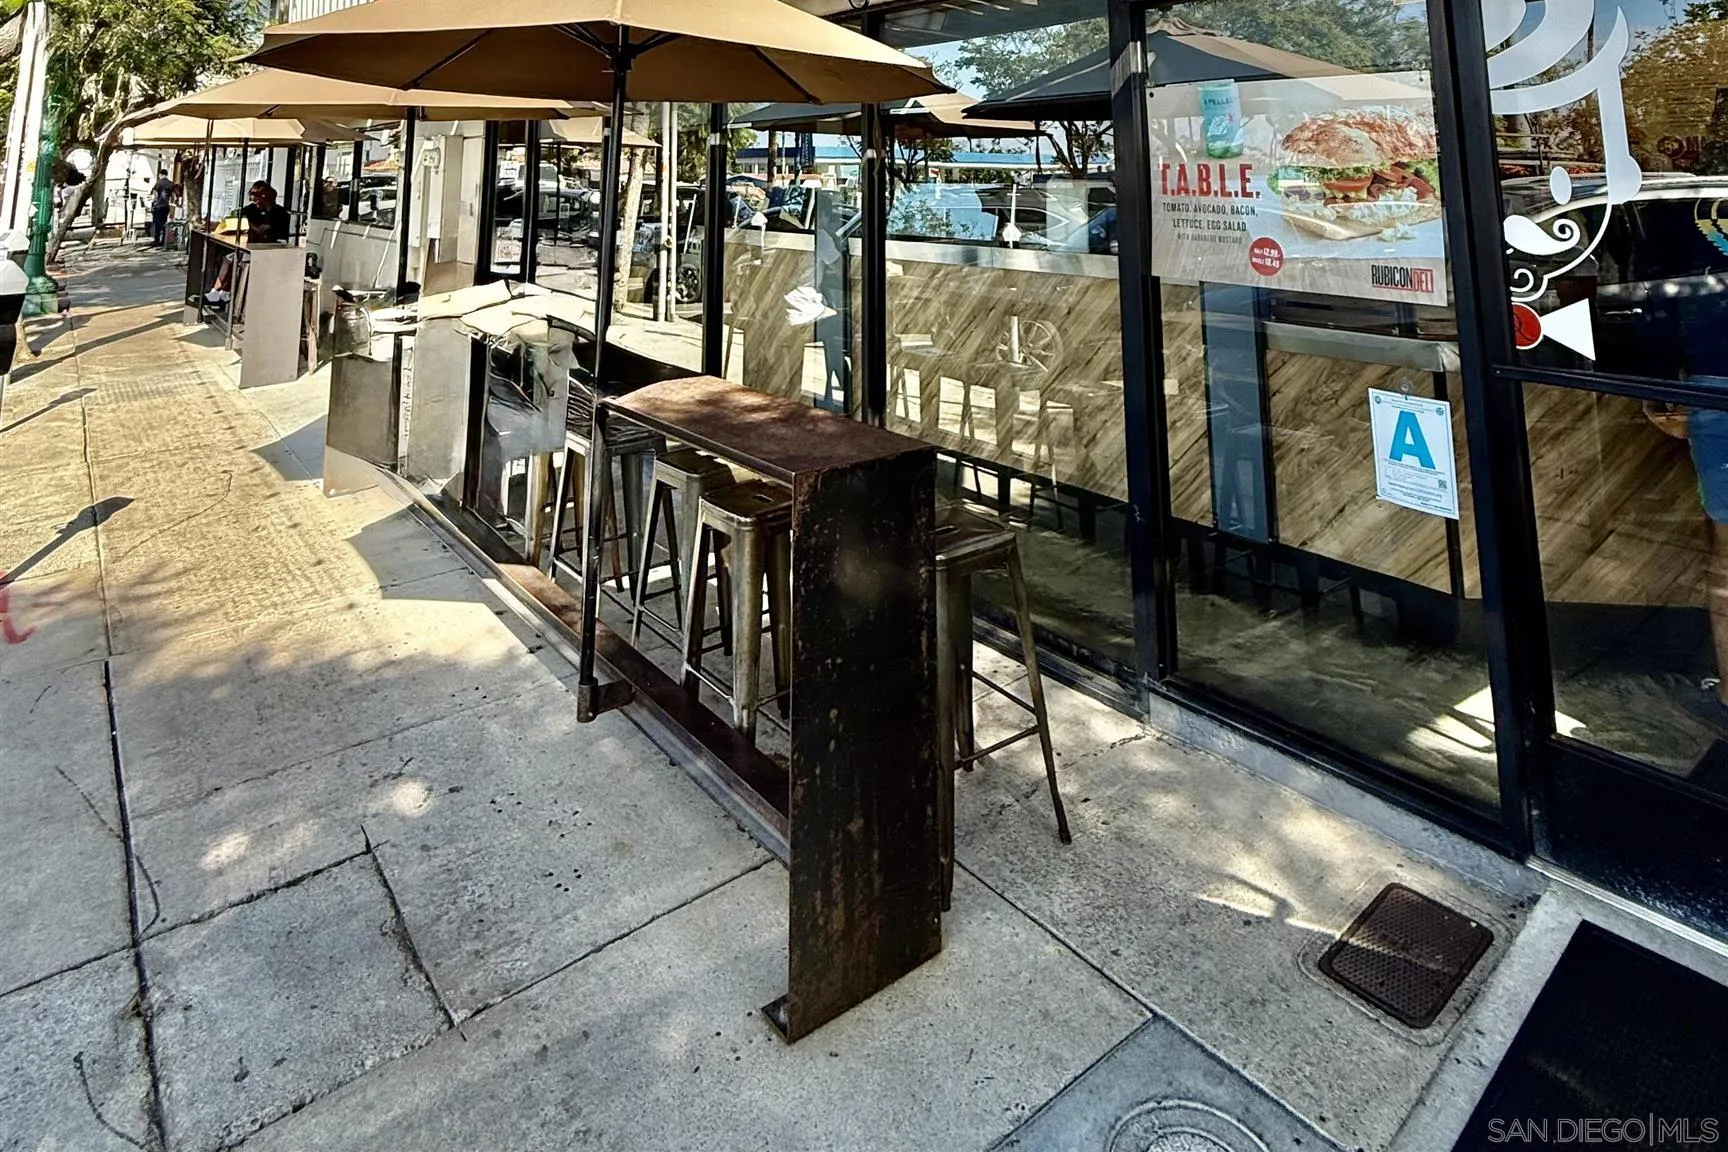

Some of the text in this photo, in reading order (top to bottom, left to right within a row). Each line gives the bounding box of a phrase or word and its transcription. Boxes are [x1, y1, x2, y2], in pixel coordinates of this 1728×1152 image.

[1158, 163, 1261, 198] T.A.B.L.E.
[1193, 204, 1229, 216] AVOCADO,
[1230, 205, 1259, 217] BACON,
[1206, 220, 1221, 231] EGG
[1223, 221, 1247, 232] SALAD
[1371, 264, 1434, 293] RUBICON DELI
[1389, 410, 1436, 470] A
